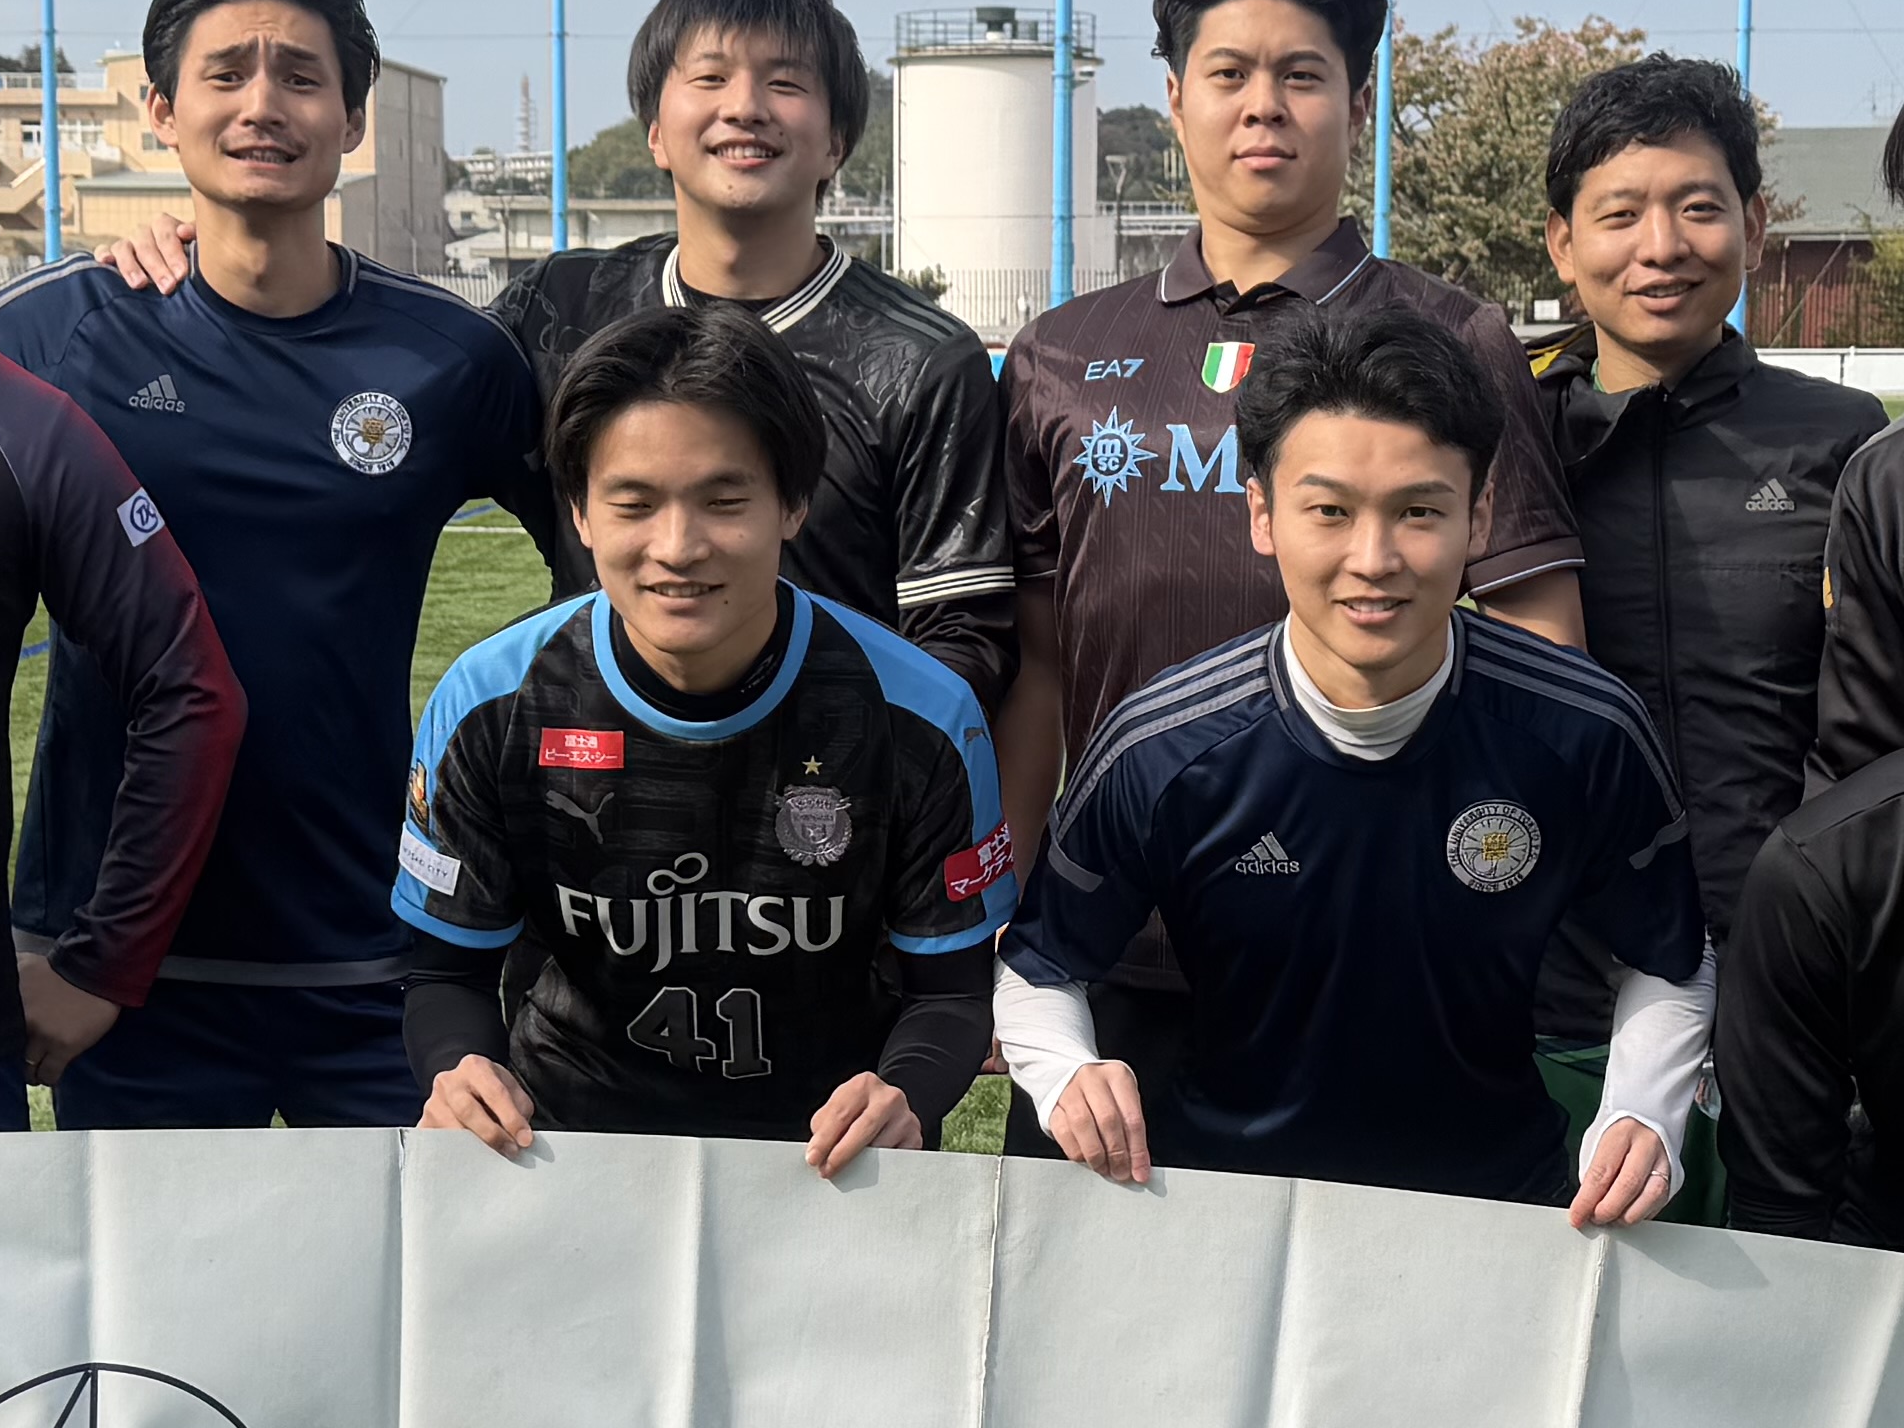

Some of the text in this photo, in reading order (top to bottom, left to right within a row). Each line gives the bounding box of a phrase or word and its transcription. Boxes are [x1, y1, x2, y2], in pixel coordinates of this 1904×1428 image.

[1084, 358, 1145, 381] EA7
[128, 395, 186, 413] adidas
[1745, 500, 1795, 511] adidas
[1235, 859, 1300, 875] adidas
[554, 853, 846, 974] FUJITSU
[626, 986, 772, 1080] 41
